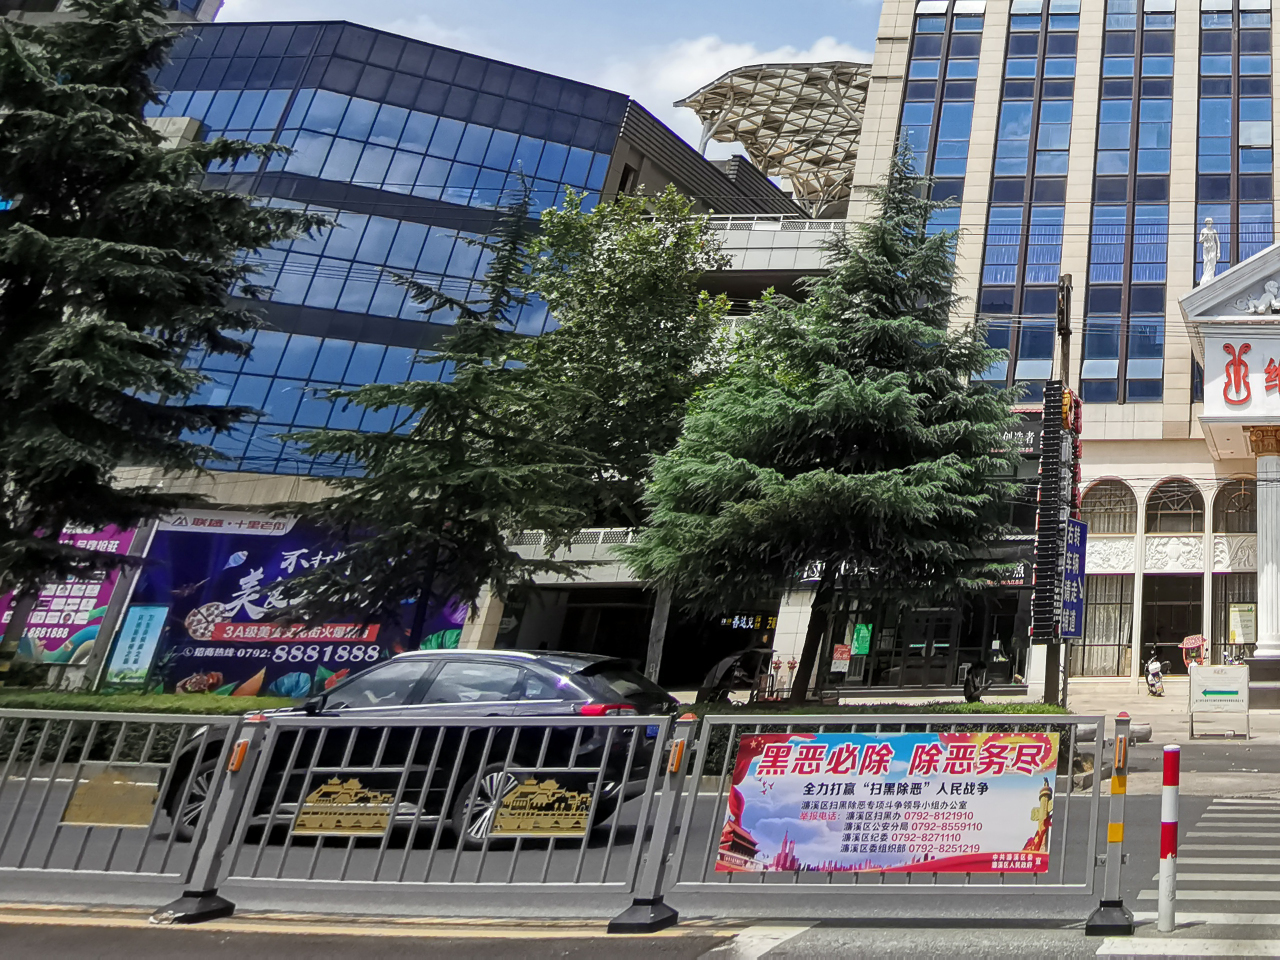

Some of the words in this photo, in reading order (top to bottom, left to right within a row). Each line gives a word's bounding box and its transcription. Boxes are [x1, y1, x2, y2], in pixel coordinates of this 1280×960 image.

[1068, 523, 1080, 547] 右转
[1066, 551, 1080, 574] 车辆
[756, 743, 894, 776] 黑恶必除
[908, 743, 1044, 776] 除恶务尽
[802, 782, 854, 796] 全力打赢
[936, 782, 989, 795] 人民战争
[801, 801, 968, 810] 濂溪区扫黑除恶专项斗争领导小组办公室
[904, 812, 974, 820] 0792-8121910
[911, 822, 982, 831] 0792-8559110
[892, 834, 961, 842] 0792-8271110
[908, 844, 980, 852] 0792-8251219
